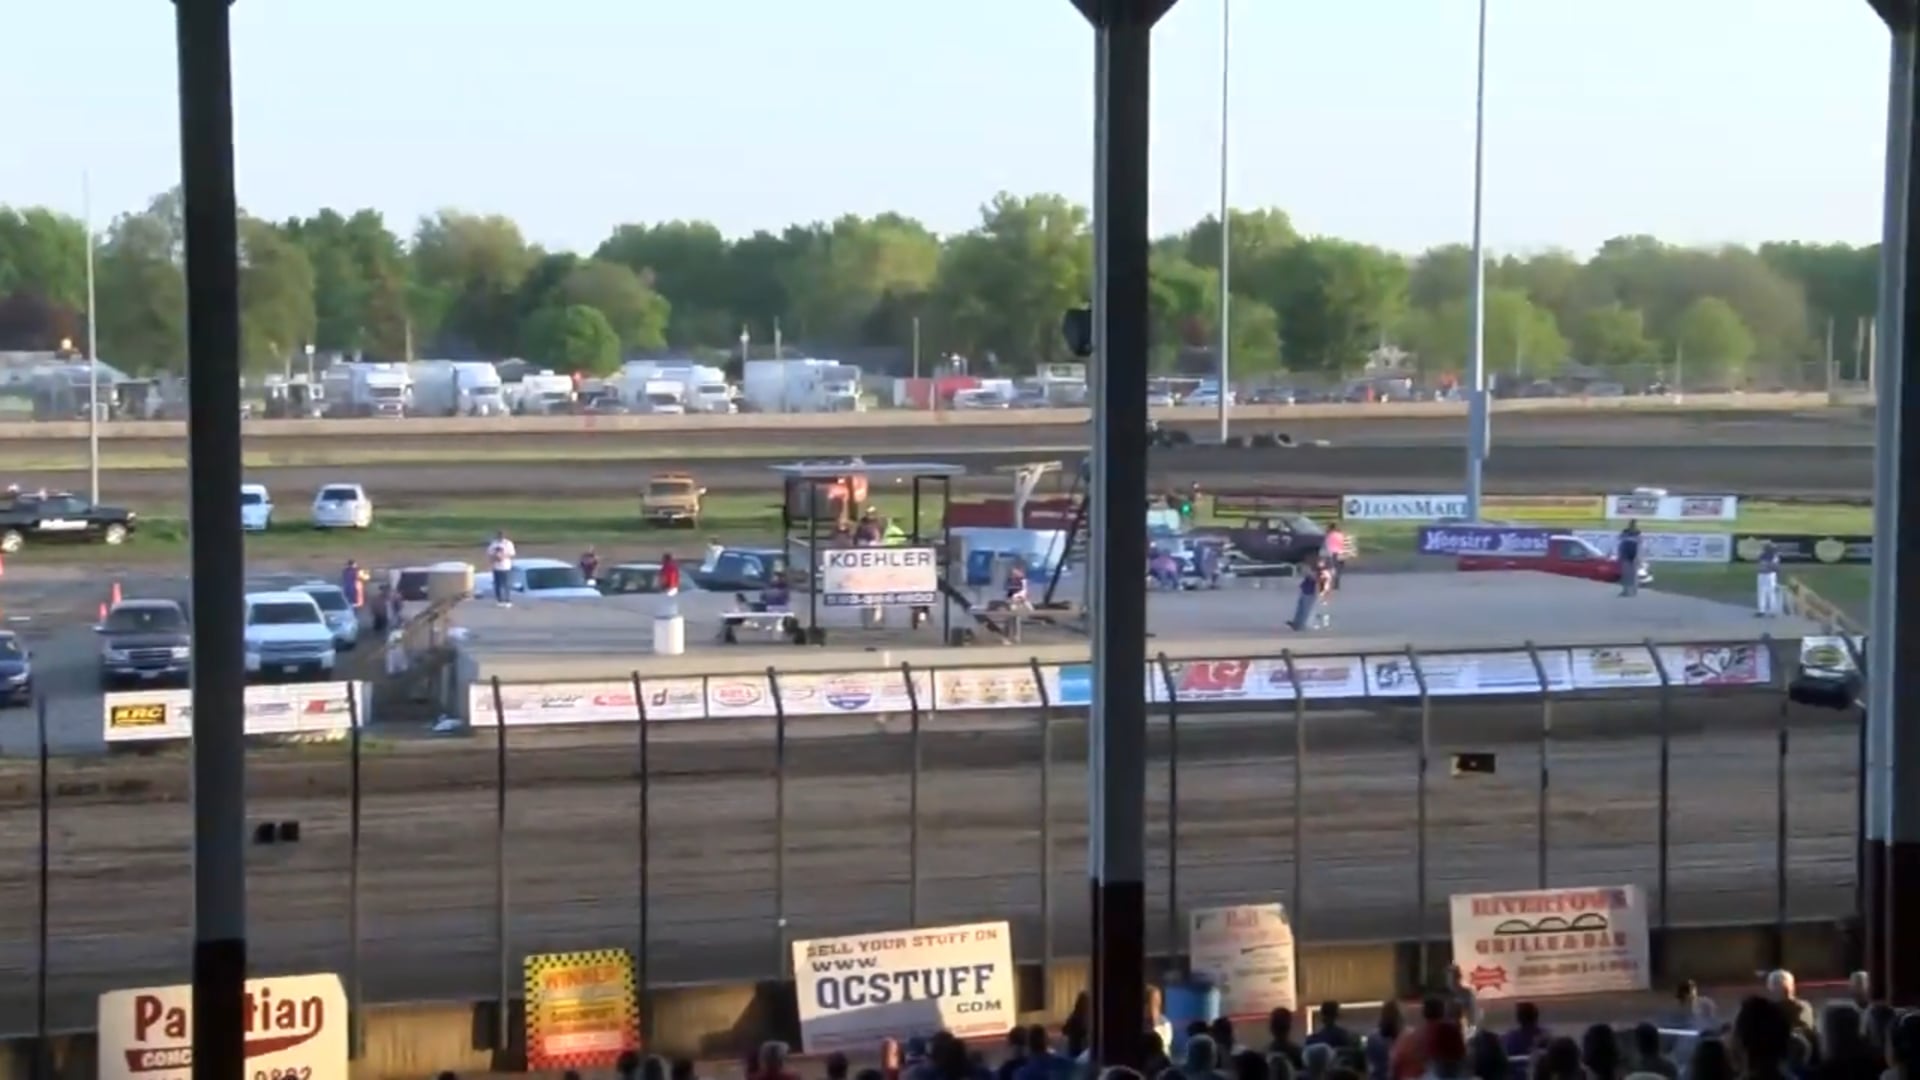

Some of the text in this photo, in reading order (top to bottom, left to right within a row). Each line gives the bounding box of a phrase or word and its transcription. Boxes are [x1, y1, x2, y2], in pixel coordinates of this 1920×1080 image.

[829, 551, 931, 568] KOEHLER
[806, 929, 998, 958] SELL YOUR STUFF ON
[815, 963, 995, 1010] QCSTUFF
